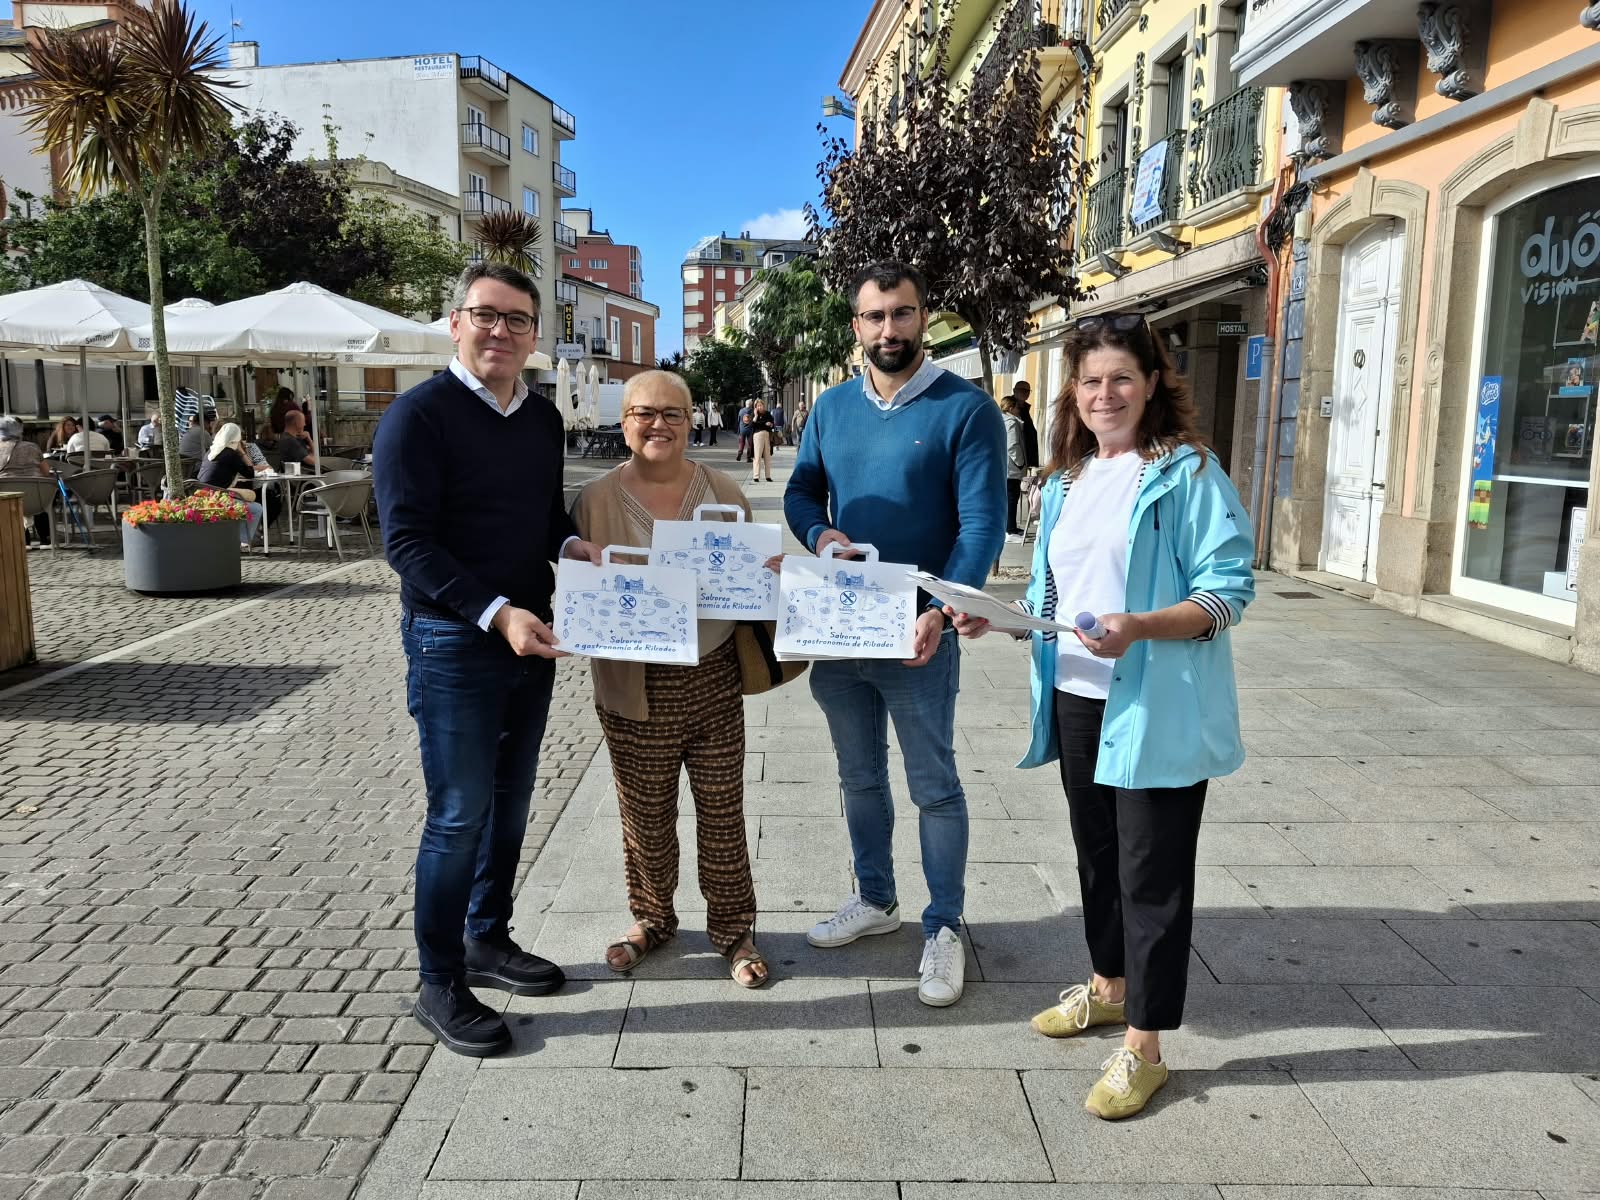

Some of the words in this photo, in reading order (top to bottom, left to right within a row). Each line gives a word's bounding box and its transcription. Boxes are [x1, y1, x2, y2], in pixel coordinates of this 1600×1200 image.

[414, 57, 453, 66] HOTEL
[1220, 325, 1246, 333] HOSTAL
[700, 592, 730, 601] Saborea
[610, 635, 642, 644] Saborea
[830, 631, 861, 640] Saborea
[645, 644, 677, 652] Ribadeo
